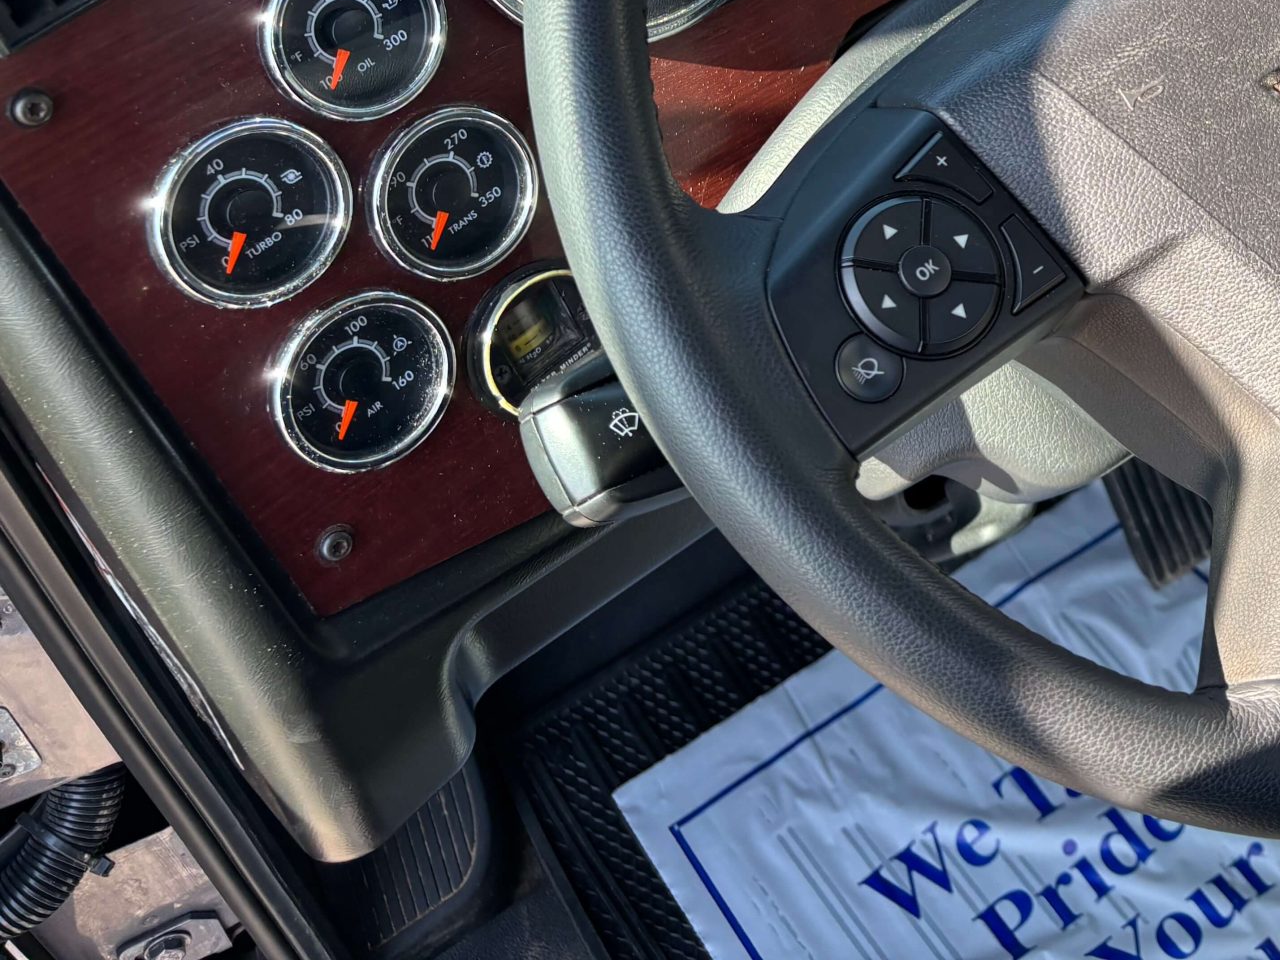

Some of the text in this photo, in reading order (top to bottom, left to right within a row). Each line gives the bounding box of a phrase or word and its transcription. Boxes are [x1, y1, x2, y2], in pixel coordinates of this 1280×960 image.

[383, 30, 408, 51] 300
[357, 58, 375, 72] OIL
[444, 129, 468, 150] 270
[206, 158, 224, 176] 40
[478, 186, 501, 208] 350
[284, 208, 304, 226] 80
[448, 210, 478, 235] TRANS
[179, 234, 200, 252] PSI
[245, 231, 282, 259] TURBO
[915, 259, 939, 281] OK
[344, 315, 368, 336] 100
[300, 353, 317, 371] 60
[391, 370, 414, 390] 160
[296, 403, 316, 421] PSI
[367, 401, 384, 418] AIR
[859, 817, 1001, 920] We
